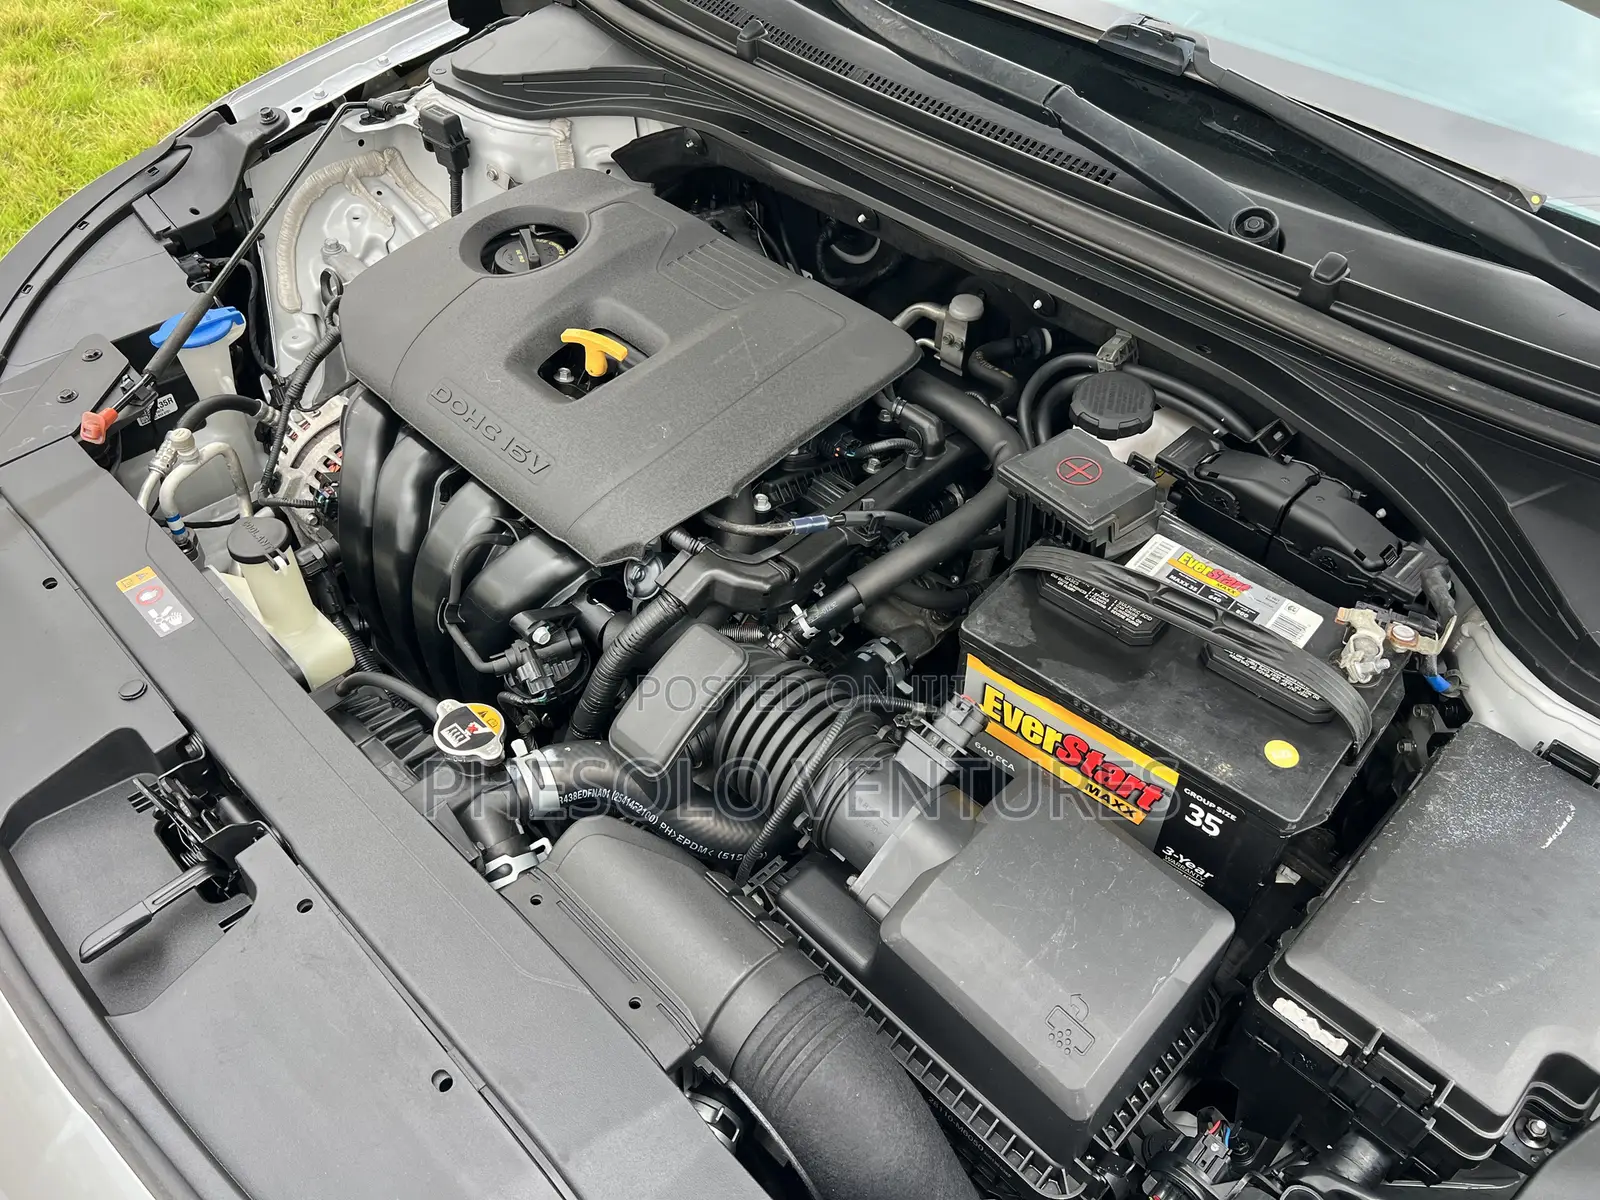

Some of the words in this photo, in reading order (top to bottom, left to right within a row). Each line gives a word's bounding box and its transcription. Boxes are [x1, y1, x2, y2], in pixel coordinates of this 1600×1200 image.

[431, 382, 502, 442] DOHC
[500, 436, 551, 475] 16V
[1168, 573, 1188, 589] MAXX
[1176, 551, 1251, 592] EverStart
[974, 741, 994, 758] 640
[995, 755, 1016, 772] CCA
[982, 683, 1166, 812] EverStart
[1084, 782, 1139, 819] MAXX
[1183, 788, 1216, 808] GROUP
[1216, 806, 1238, 822] SIZE
[1184, 802, 1224, 837] 35
[1162, 846, 1215, 879] 3-Year
[1164, 855, 1206, 881] WARRANTY
